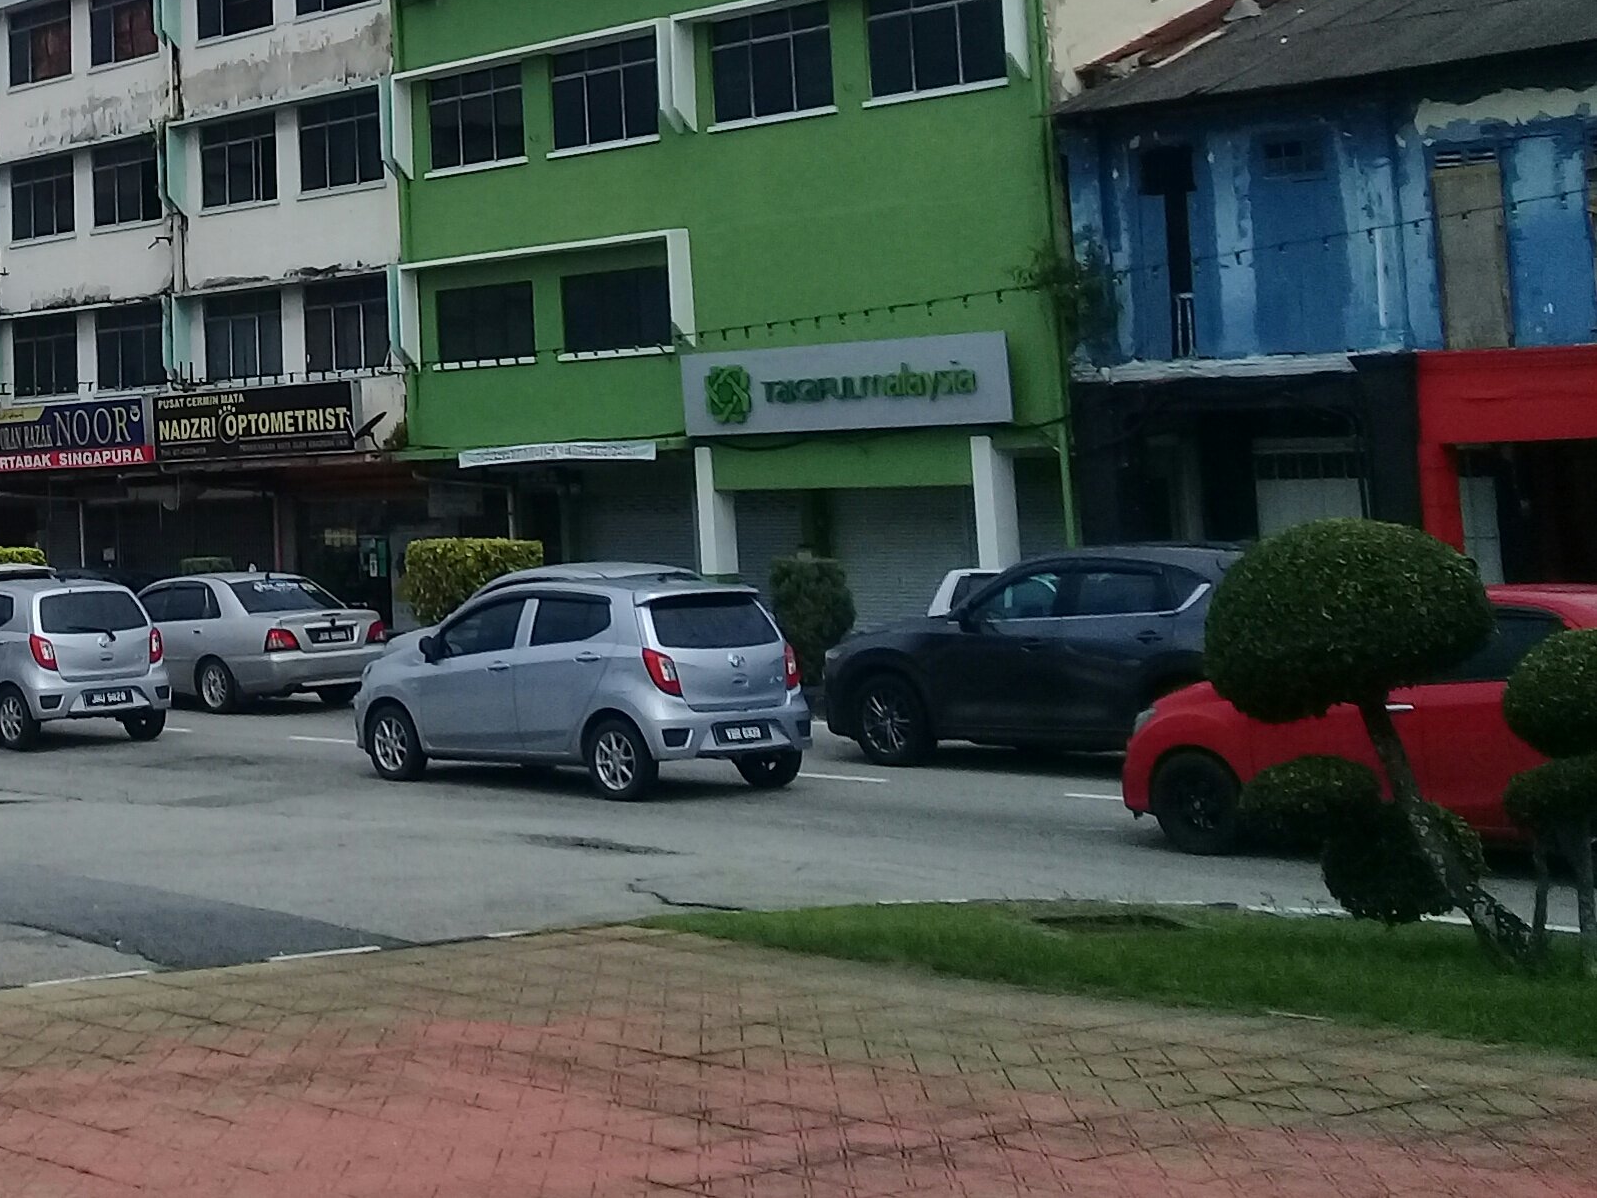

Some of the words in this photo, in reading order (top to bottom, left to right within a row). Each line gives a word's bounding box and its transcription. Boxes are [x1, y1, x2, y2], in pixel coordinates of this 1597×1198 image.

[158, 398, 185, 409] PUSAT
[187, 395, 218, 407] CERMIN
[221, 393, 244, 405] MATA
[53, 406, 131, 447] NOOR
[159, 417, 216, 440] NADZRI
[226, 407, 348, 436] OPTOMETRIST
[59, 448, 144, 466] SINGAPURA
